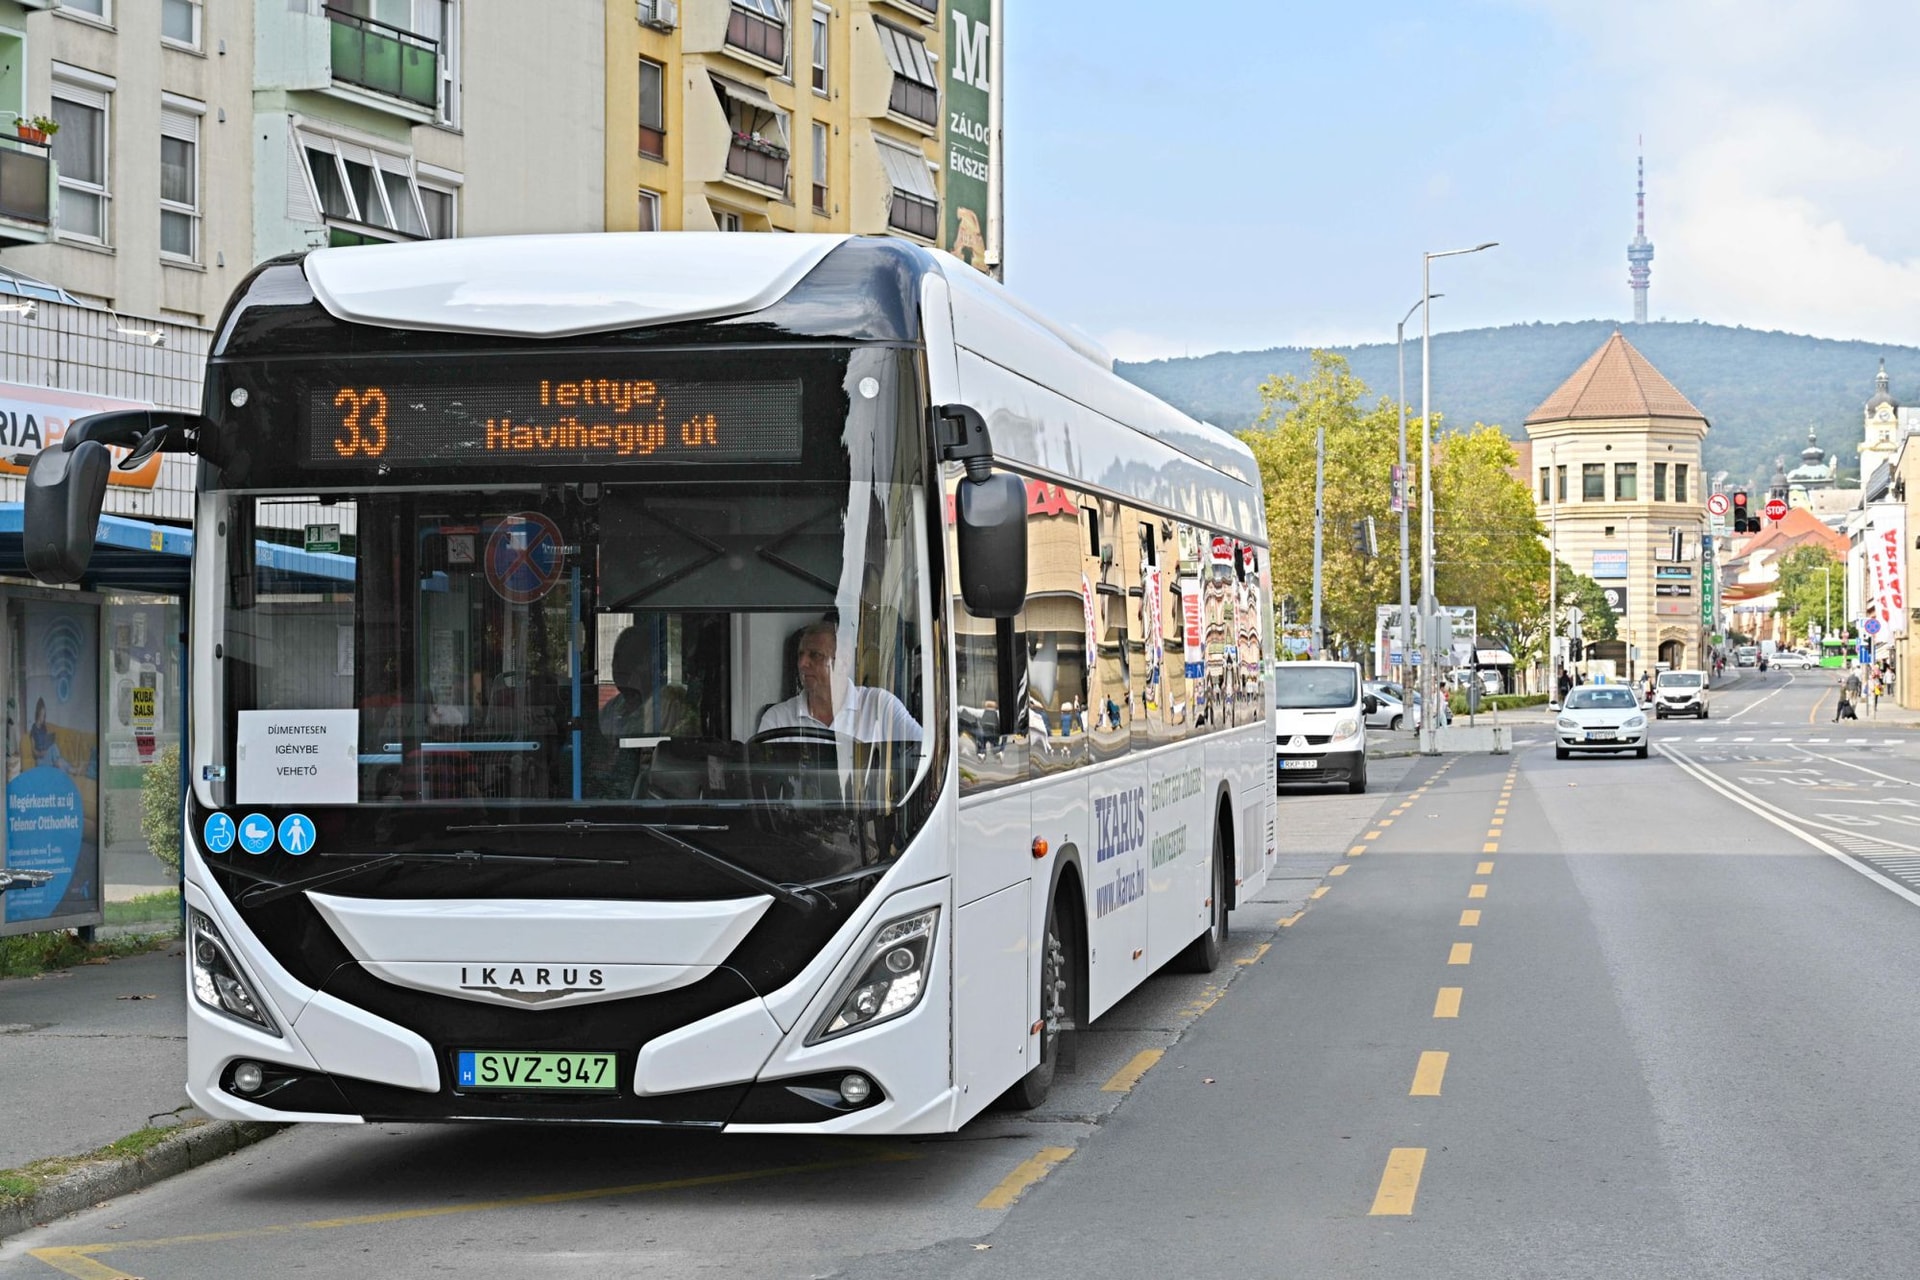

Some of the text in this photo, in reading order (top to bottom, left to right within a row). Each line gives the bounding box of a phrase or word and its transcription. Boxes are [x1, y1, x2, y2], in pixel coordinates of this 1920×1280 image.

[952, 9, 989, 93] M
[334, 388, 386, 456] 33
[486, 414, 717, 454] Havihegyi út
[1766, 505, 1786, 515] STOP
[1703, 551, 1712, 623] CENTRUM
[267, 724, 327, 735] DÍJMENTESEN
[275, 743, 319, 754] IGÉNYBE
[276, 764, 318, 776] VEHETŐ
[9, 794, 56, 813] Megérkezett
[57, 796, 66, 808] az
[9, 817, 37, 832] Telenor
[1094, 786, 1145, 863] IKARUS
[1096, 859, 1145, 920] www.ikarus.hu
[461, 967, 603, 986] IKARUS
[463, 1071, 471, 1081] H
[481, 1056, 609, 1084] SVZ-947
